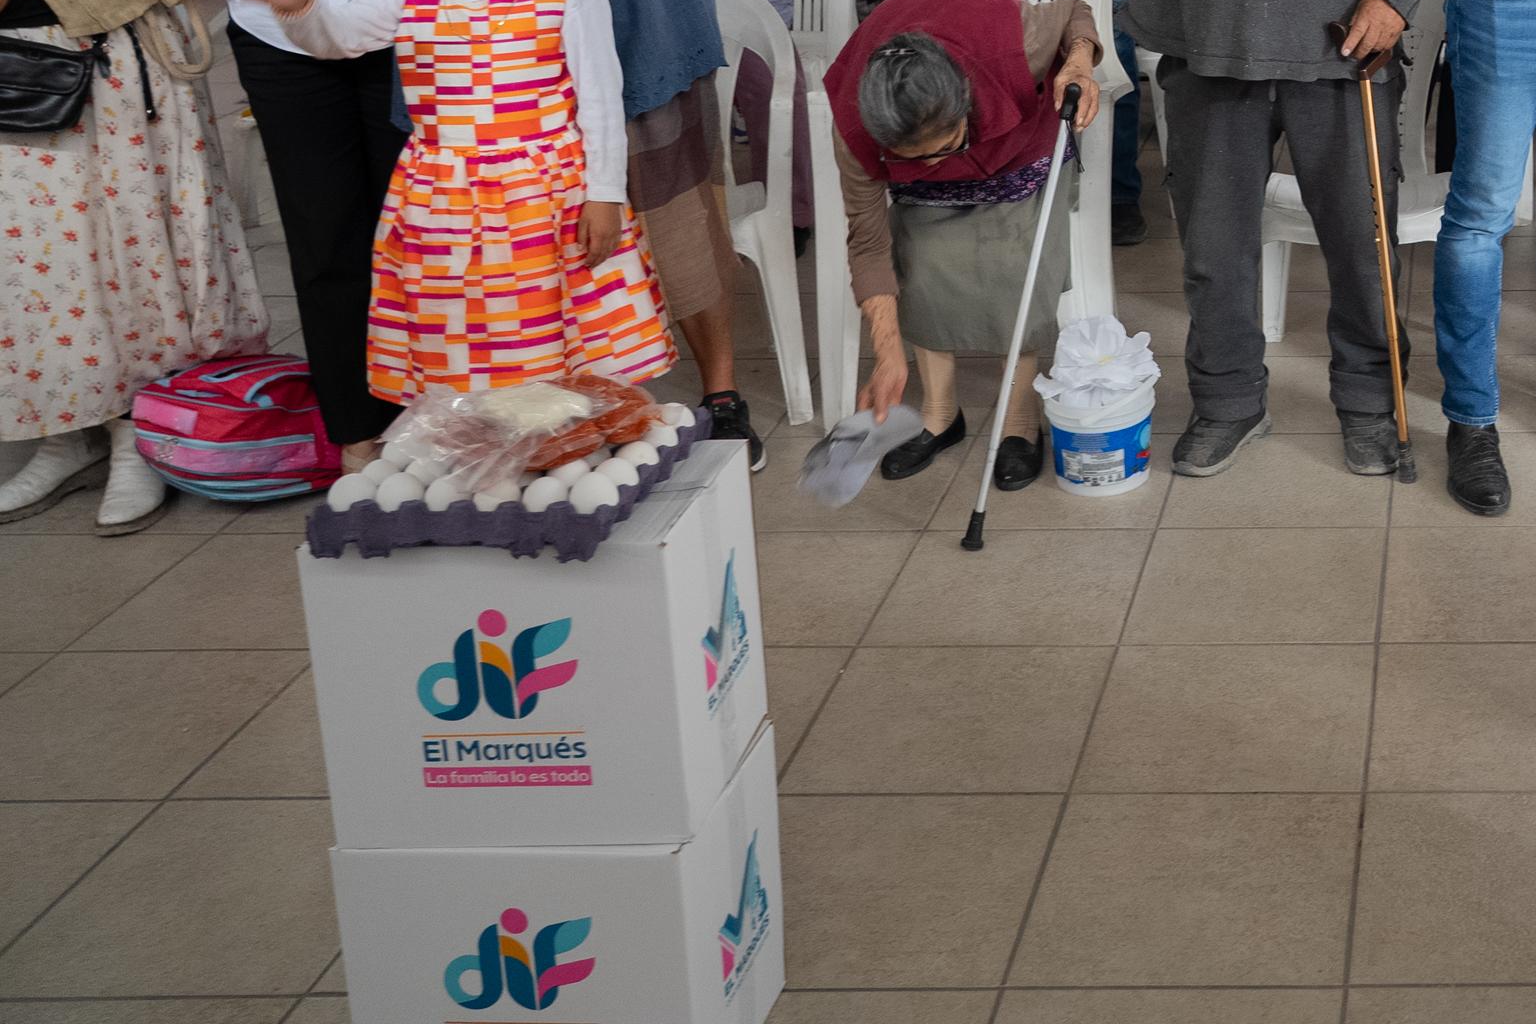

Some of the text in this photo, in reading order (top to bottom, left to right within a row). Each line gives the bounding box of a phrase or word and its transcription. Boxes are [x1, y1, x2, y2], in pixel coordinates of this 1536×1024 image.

[422, 736, 587, 763] El Marqués
[426, 770, 589, 784] La familia lo es todo
